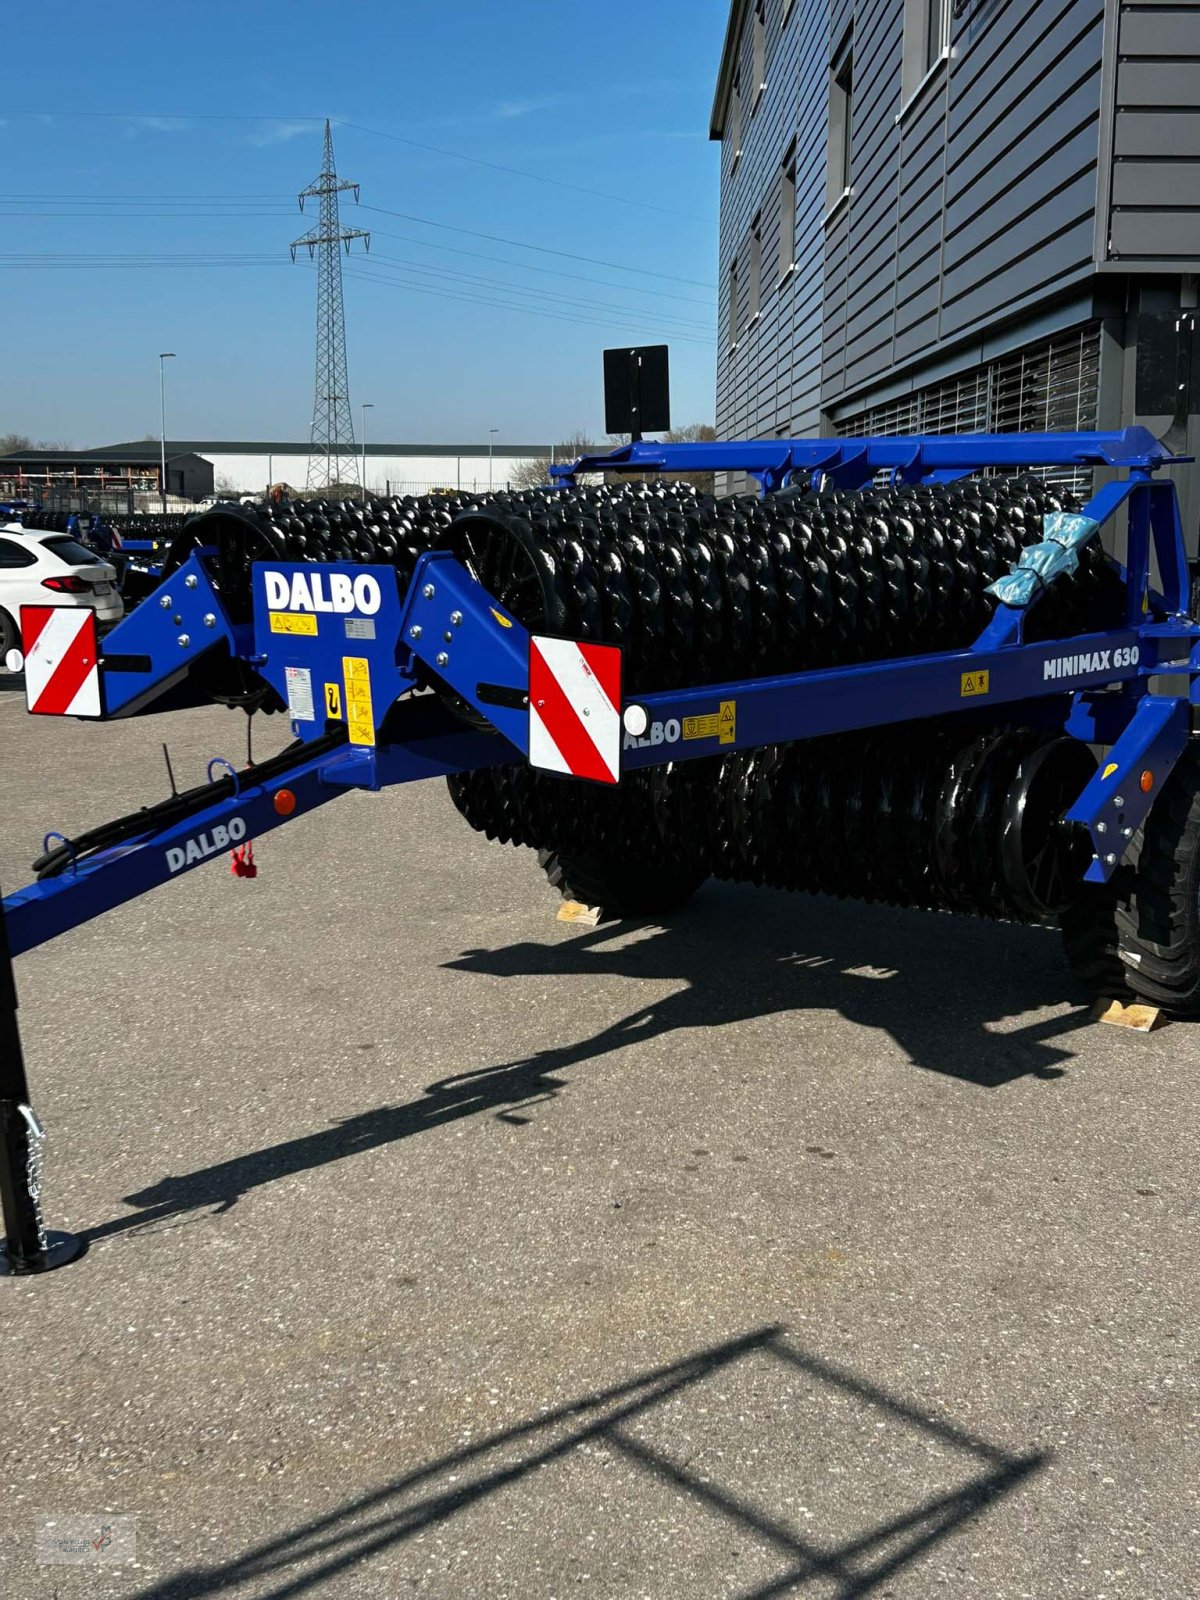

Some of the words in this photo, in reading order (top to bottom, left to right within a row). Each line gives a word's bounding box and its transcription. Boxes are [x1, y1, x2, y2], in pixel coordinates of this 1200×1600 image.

[264, 571, 381, 615] DALBO
[1043, 650, 1111, 681] MINIMAX
[1113, 646, 1140, 668] 630
[165, 817, 247, 872] DALBO
